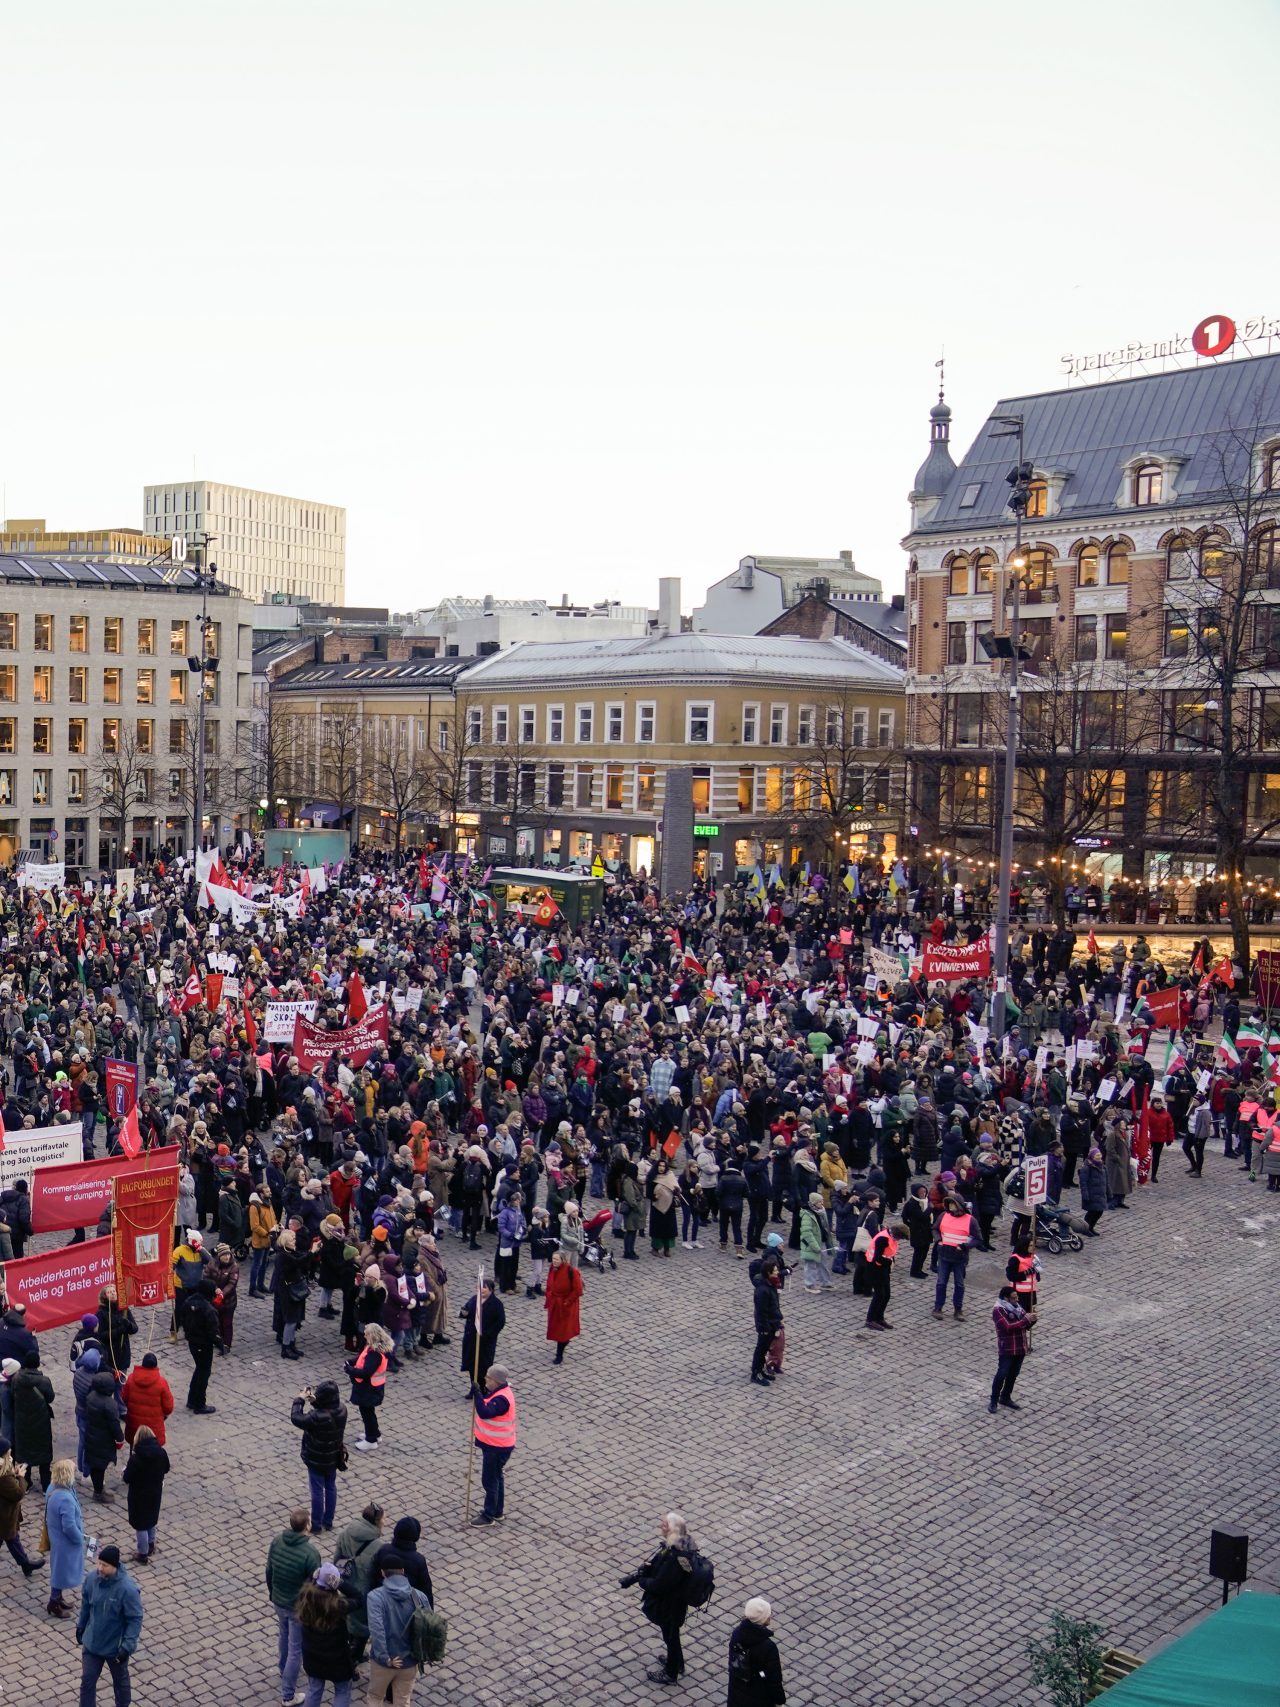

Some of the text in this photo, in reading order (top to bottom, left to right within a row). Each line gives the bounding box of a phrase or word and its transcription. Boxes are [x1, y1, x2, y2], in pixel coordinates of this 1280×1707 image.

[1057, 333, 1188, 376] SpareBank
[1203, 321, 1220, 350] 1
[273, 1013, 307, 1022] SKOLN
[353, 1030, 380, 1044] STANS
[30, 1141, 69, 1153] tariffavtale
[17, 1157, 31, 1165] 360
[32, 1152, 65, 1163] Logistics!
[1028, 1159, 1046, 1168] Pulje
[42, 1179, 106, 1194] Kommersialisering
[121, 1175, 175, 1193] FAGFORBUNDET
[1030, 1170, 1044, 1194] 5
[64, 1194, 72, 1202] er
[73, 1189, 104, 1201] dumping
[139, 1191, 156, 1199] OSLO
[18, 1255, 114, 1291] Arbeiderkamp er kvi
[28, 1287, 49, 1303] hele
[50, 1285, 64, 1298] og
[66, 1278, 92, 1293] faste
